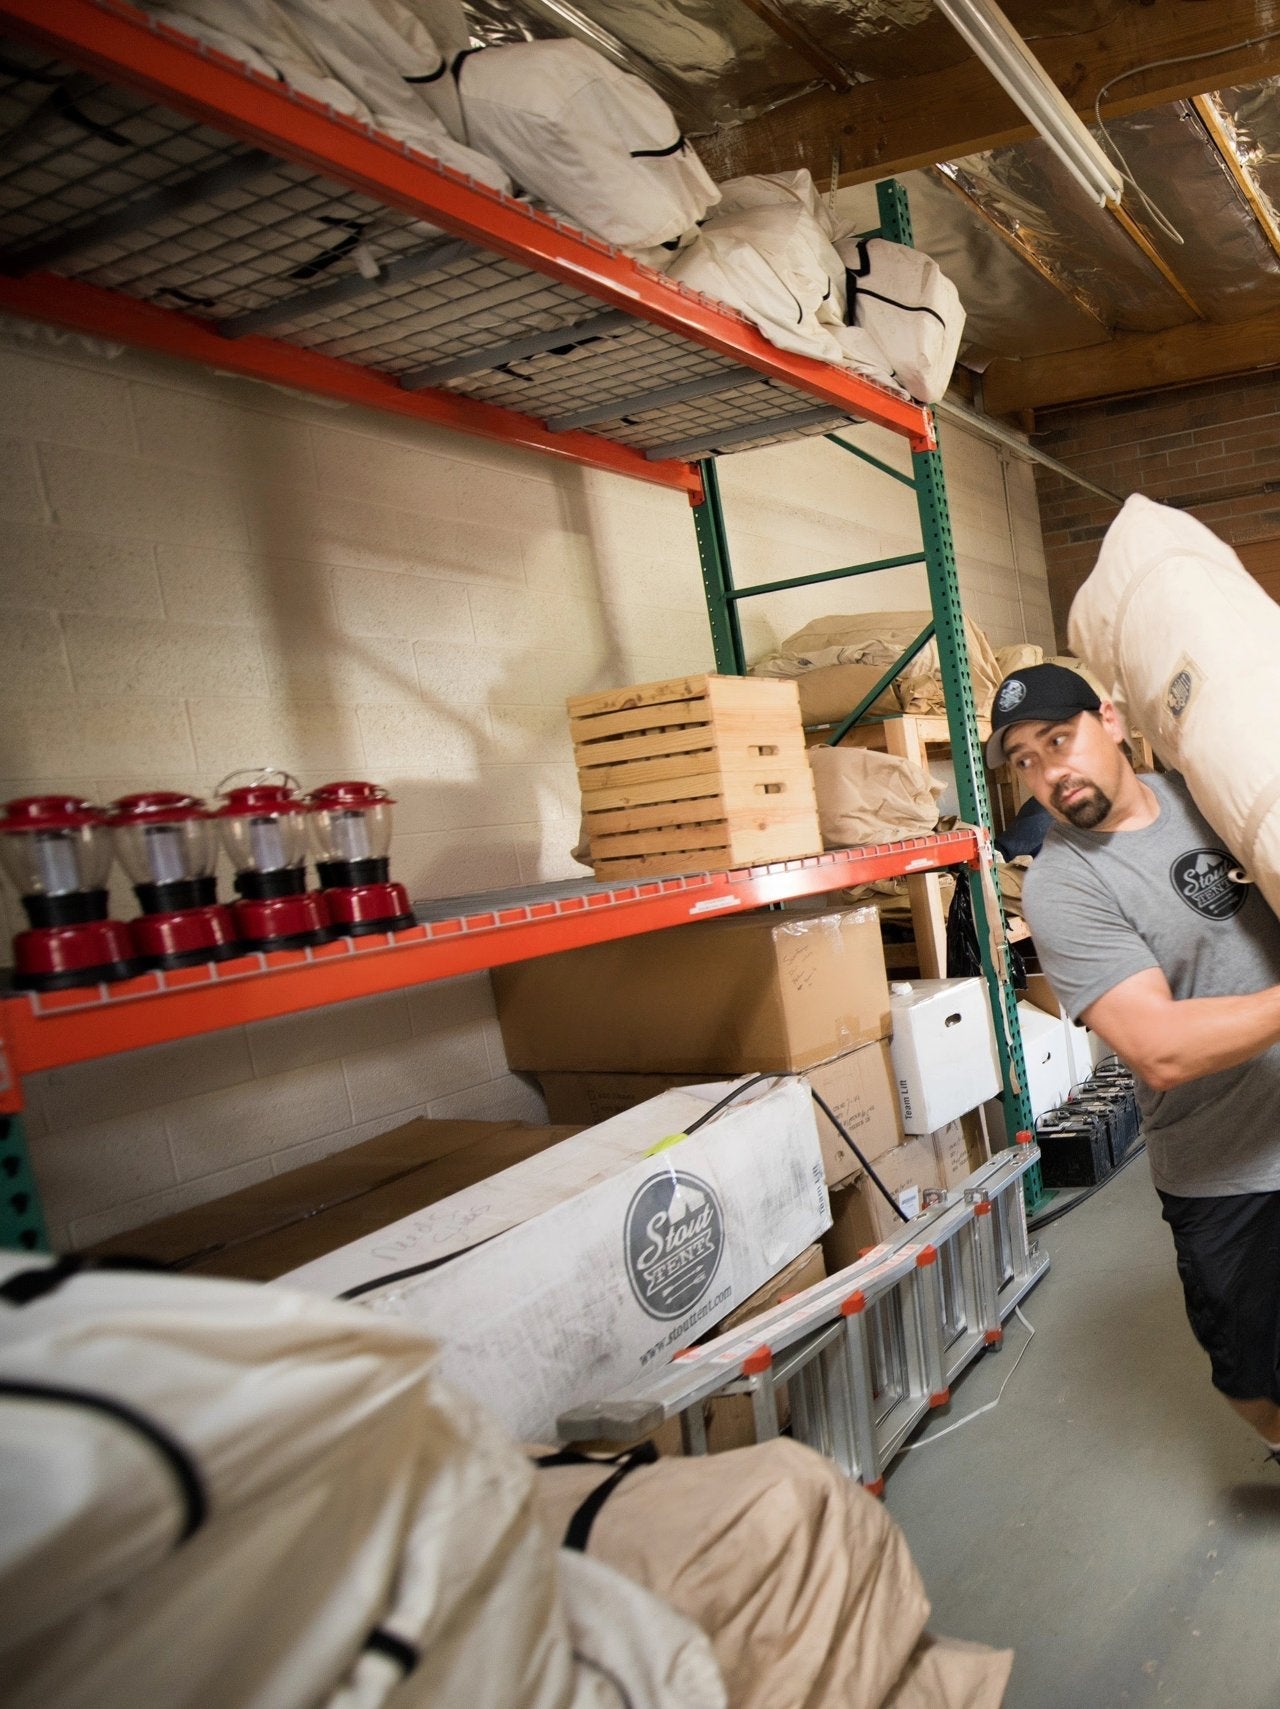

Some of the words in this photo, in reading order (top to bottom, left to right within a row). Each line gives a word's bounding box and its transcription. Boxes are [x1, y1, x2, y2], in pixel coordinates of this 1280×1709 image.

[1199, 879, 1232, 903] TENT
[903, 1096, 912, 1120] Team
[637, 1205, 714, 1271] Stout
[654, 1239, 706, 1284] TENT
[640, 1286, 732, 1366] www.stouttent.com
